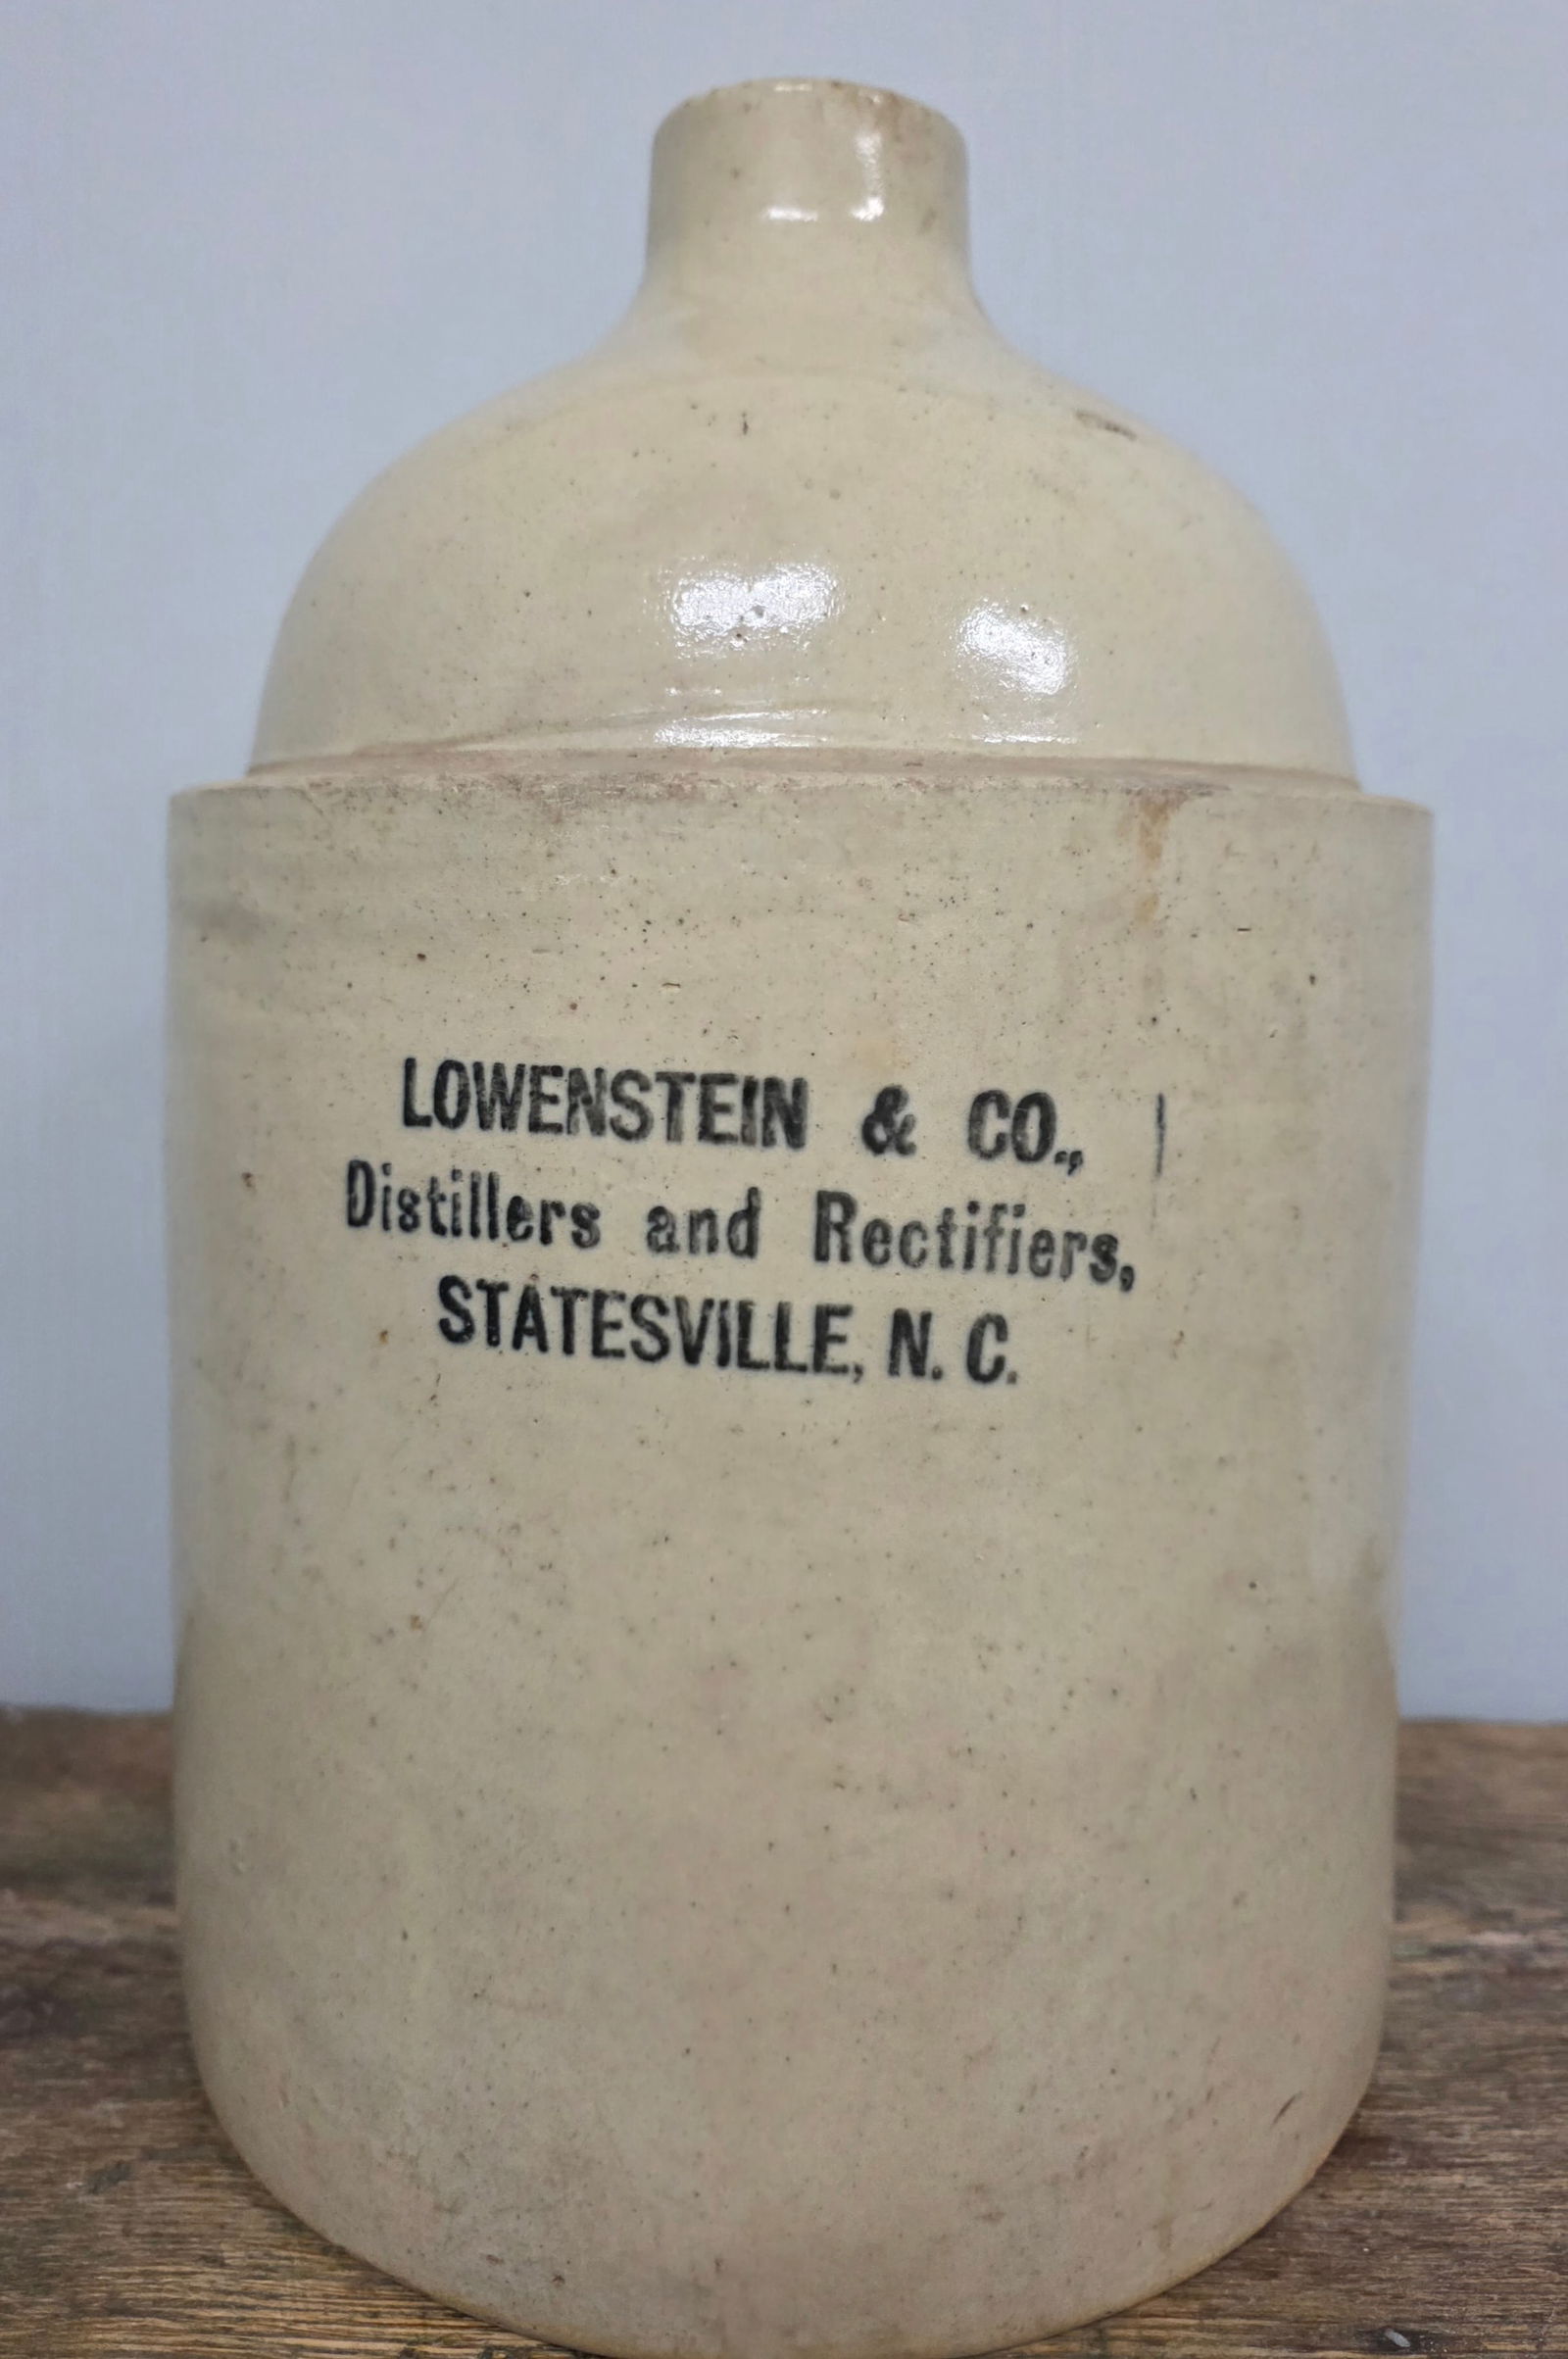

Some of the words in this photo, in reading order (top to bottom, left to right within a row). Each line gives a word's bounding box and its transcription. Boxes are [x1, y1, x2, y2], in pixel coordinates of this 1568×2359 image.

[401, 1057, 809, 1150] LOWENSTEIN
[860, 1084, 917, 1157] &
[966, 1088, 1085, 1176] CO.,
[345, 1157, 602, 1251] Distillers
[644, 1185, 762, 1260] and
[812, 1189, 1136, 1293] Rectifiers,
[436, 1273, 864, 1384] STATESVILLE,
[886, 1306, 945, 1382] N.
[964, 1311, 1018, 1385] C.
